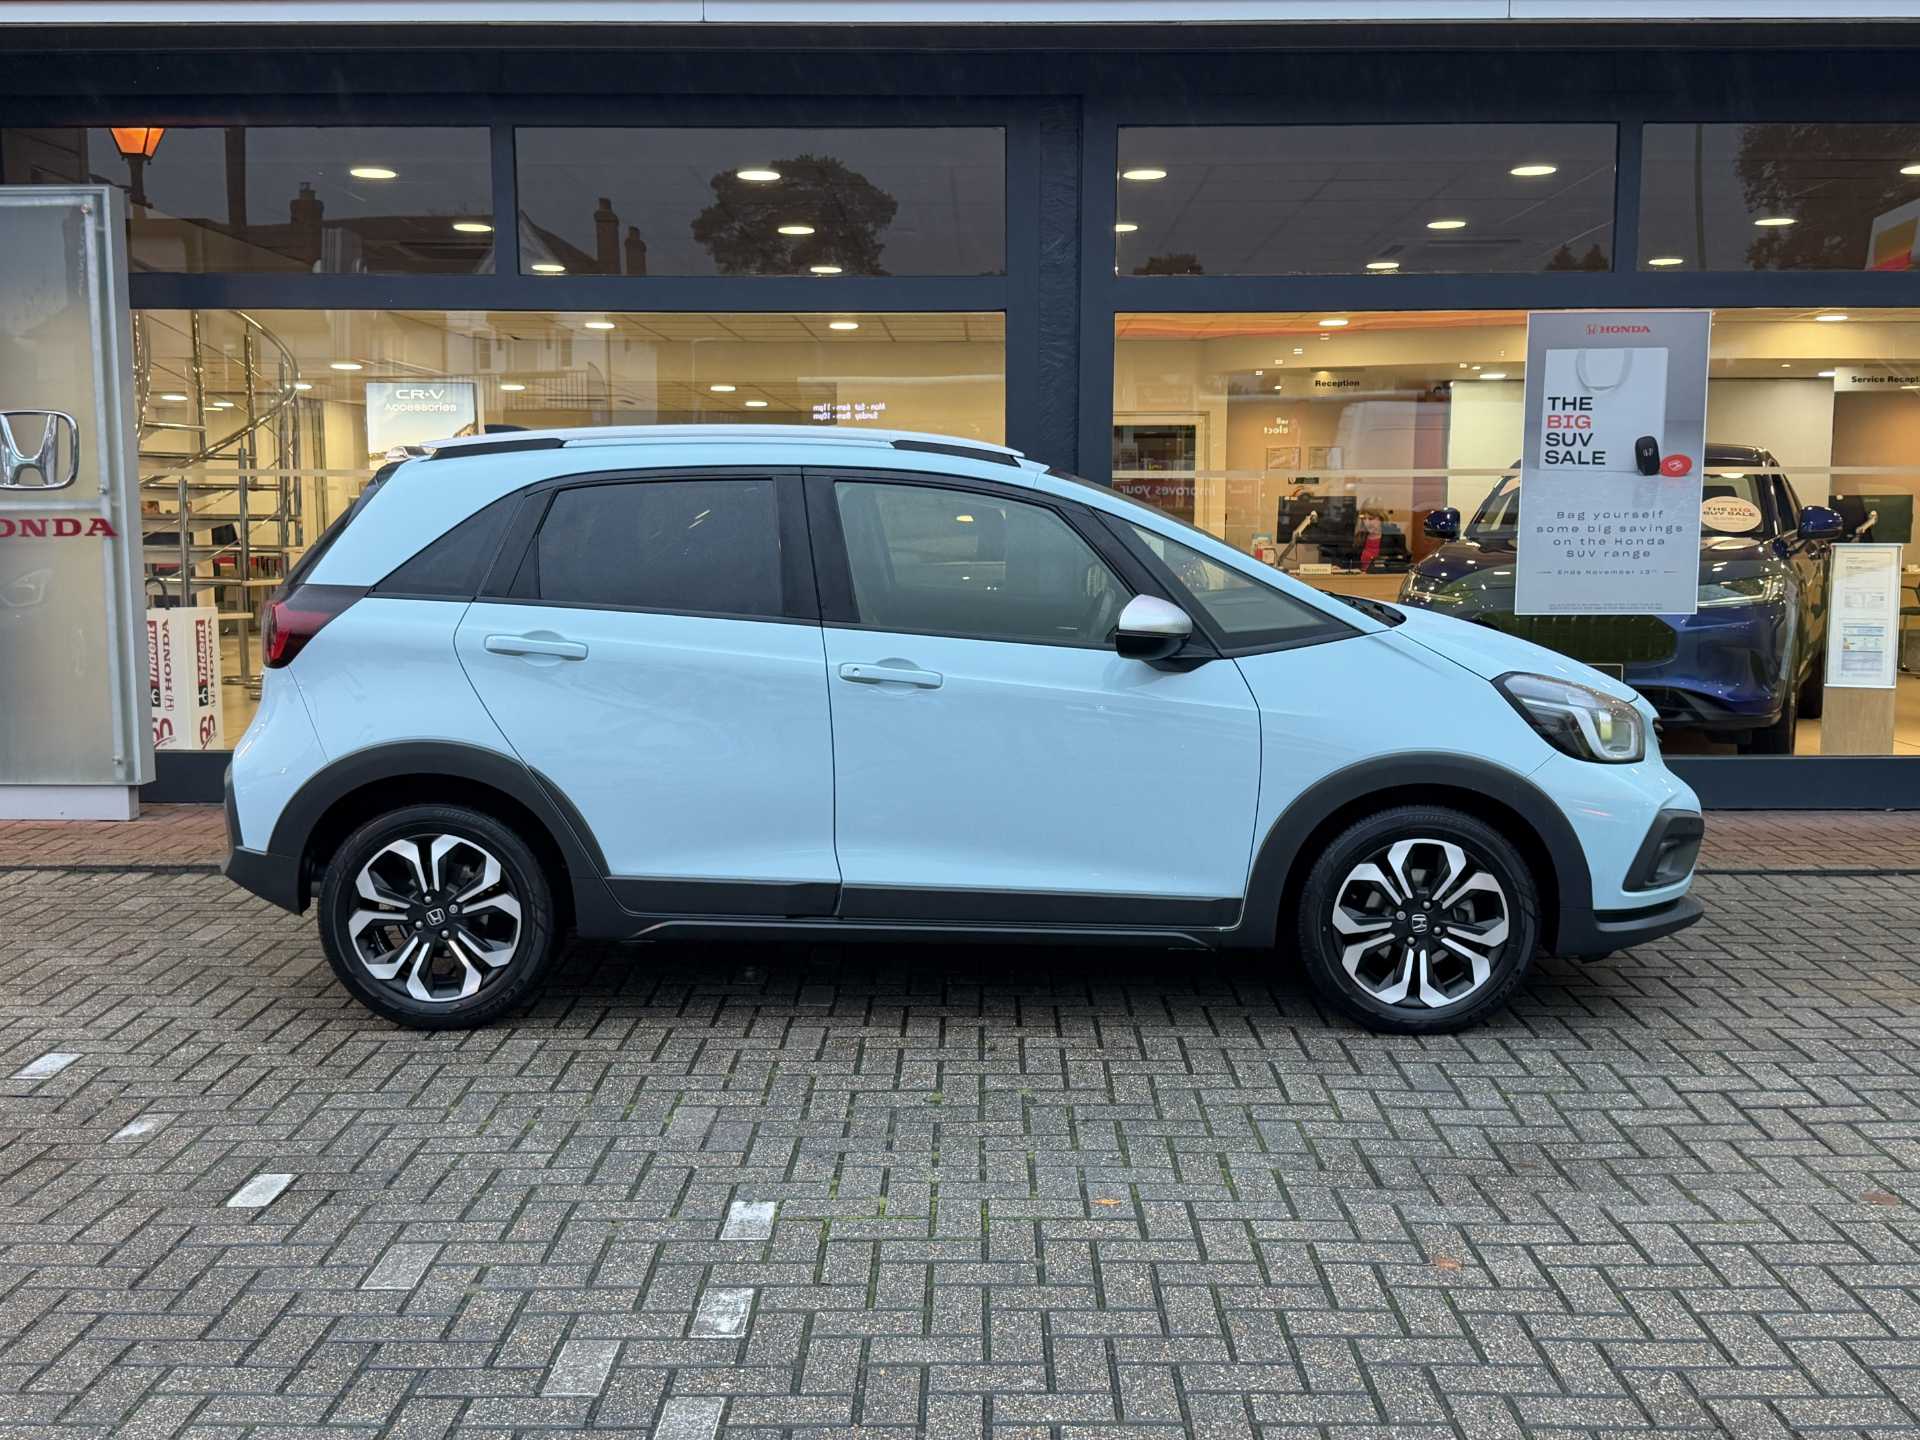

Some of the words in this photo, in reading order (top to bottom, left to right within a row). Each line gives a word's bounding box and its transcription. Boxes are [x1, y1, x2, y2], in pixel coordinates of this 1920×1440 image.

[1600, 325, 1650, 334] HONDA
[1315, 379, 1360, 388] Reception
[1851, 375, 1885, 383] Service
[384, 402, 456, 412] Accessories
[1547, 396, 1593, 411] THE
[1547, 414, 1592, 429] BIG
[1545, 432, 1594, 447] SUV
[1544, 450, 1607, 465] SALE
[1556, 510, 1586, 520] Bag
[1593, 510, 1664, 520] yourself
[1536, 525, 1580, 534] some
[1587, 524, 1612, 535] big
[1619, 524, 1683, 535] savings
[1552, 538, 1572, 546] on
[1580, 537, 1606, 546] the
[1614, 537, 1665, 546] Honda
[1566, 550, 1597, 558] SUV
[1604, 551, 1651, 560] range
[162, 618, 173, 692] HONDA
[197, 621, 208, 681] Trident
[208, 617, 216, 689] HONDA
